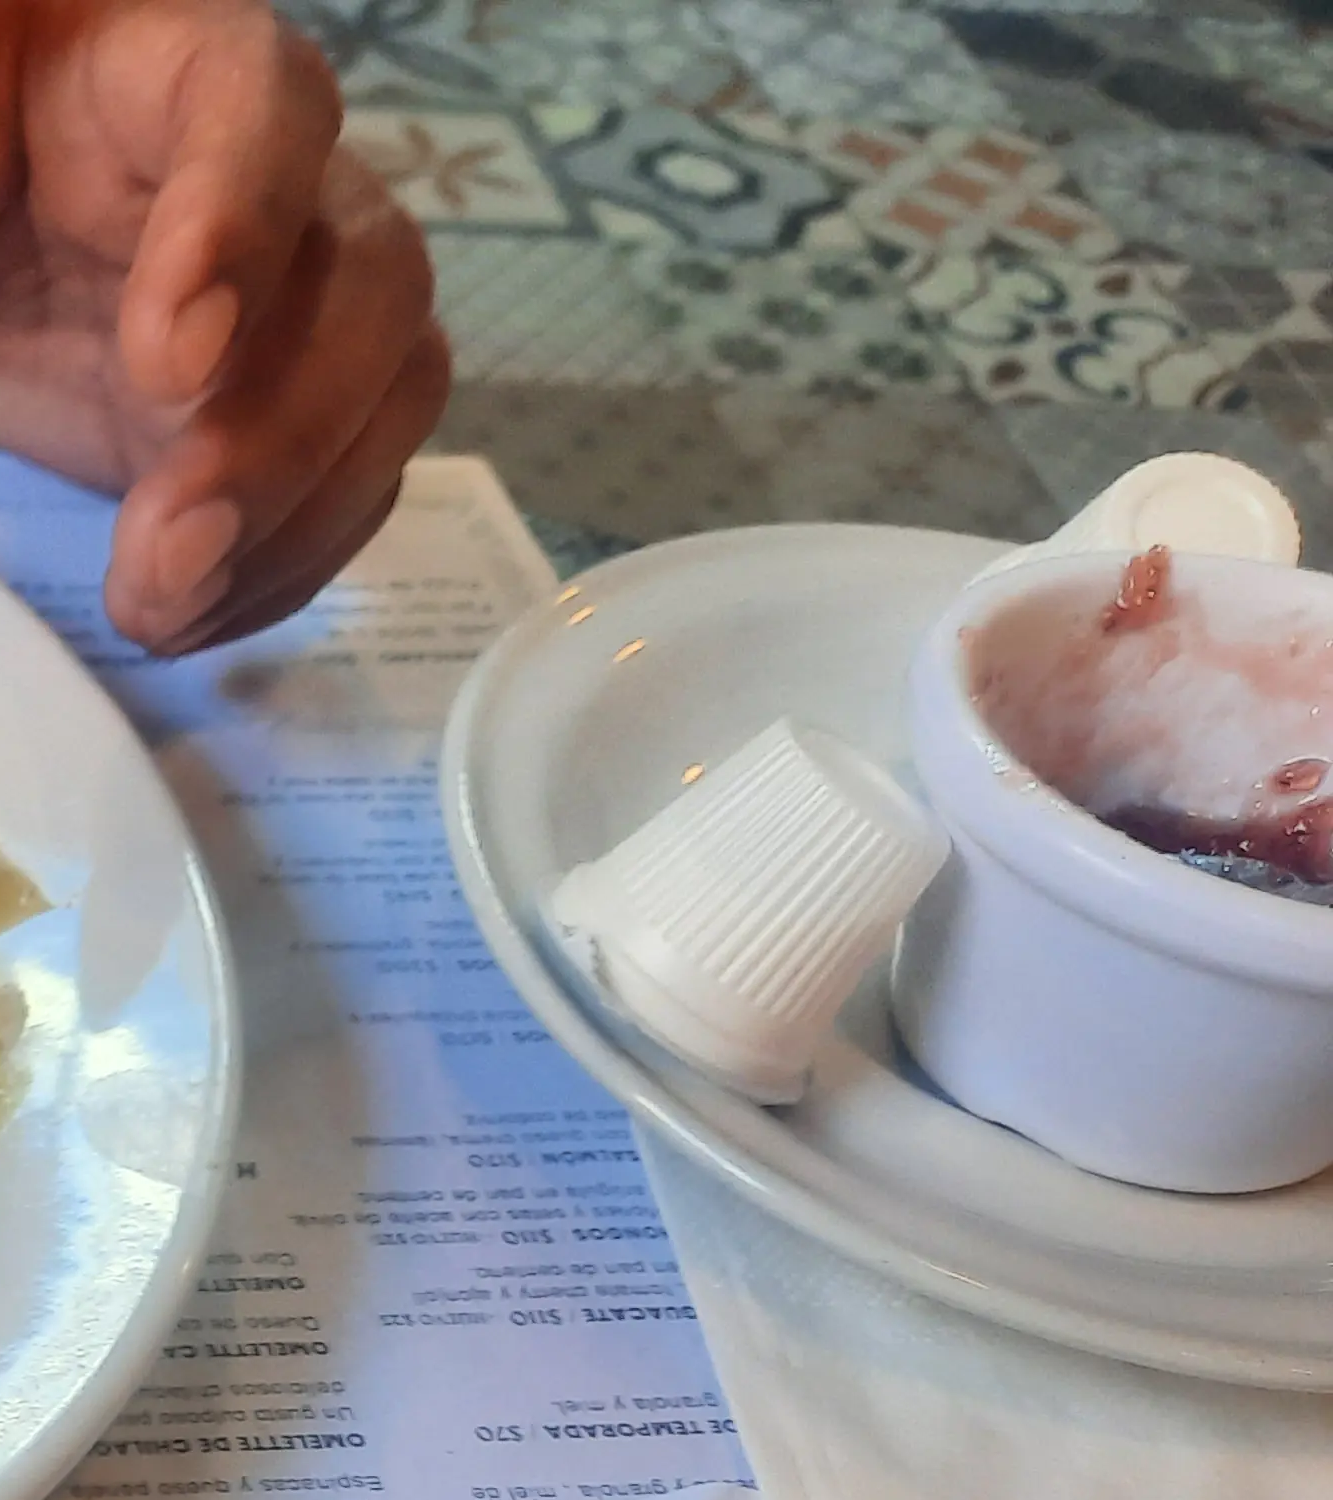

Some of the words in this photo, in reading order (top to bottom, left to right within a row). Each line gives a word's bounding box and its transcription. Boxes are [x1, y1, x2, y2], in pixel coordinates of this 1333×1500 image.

[196, 1276, 306, 1293] OMELETT
[509, 1307, 563, 1327] $110
[613, 1396, 625, 1412] y
[474, 1424, 524, 1443] $70
[542, 1419, 704, 1441] TEMPORADA
[197, 1435, 232, 1453] DE
[236, 1432, 368, 1453] OMELETTE
[240, 1475, 253, 1493] y
[258, 1474, 385, 1494] Espinacas
